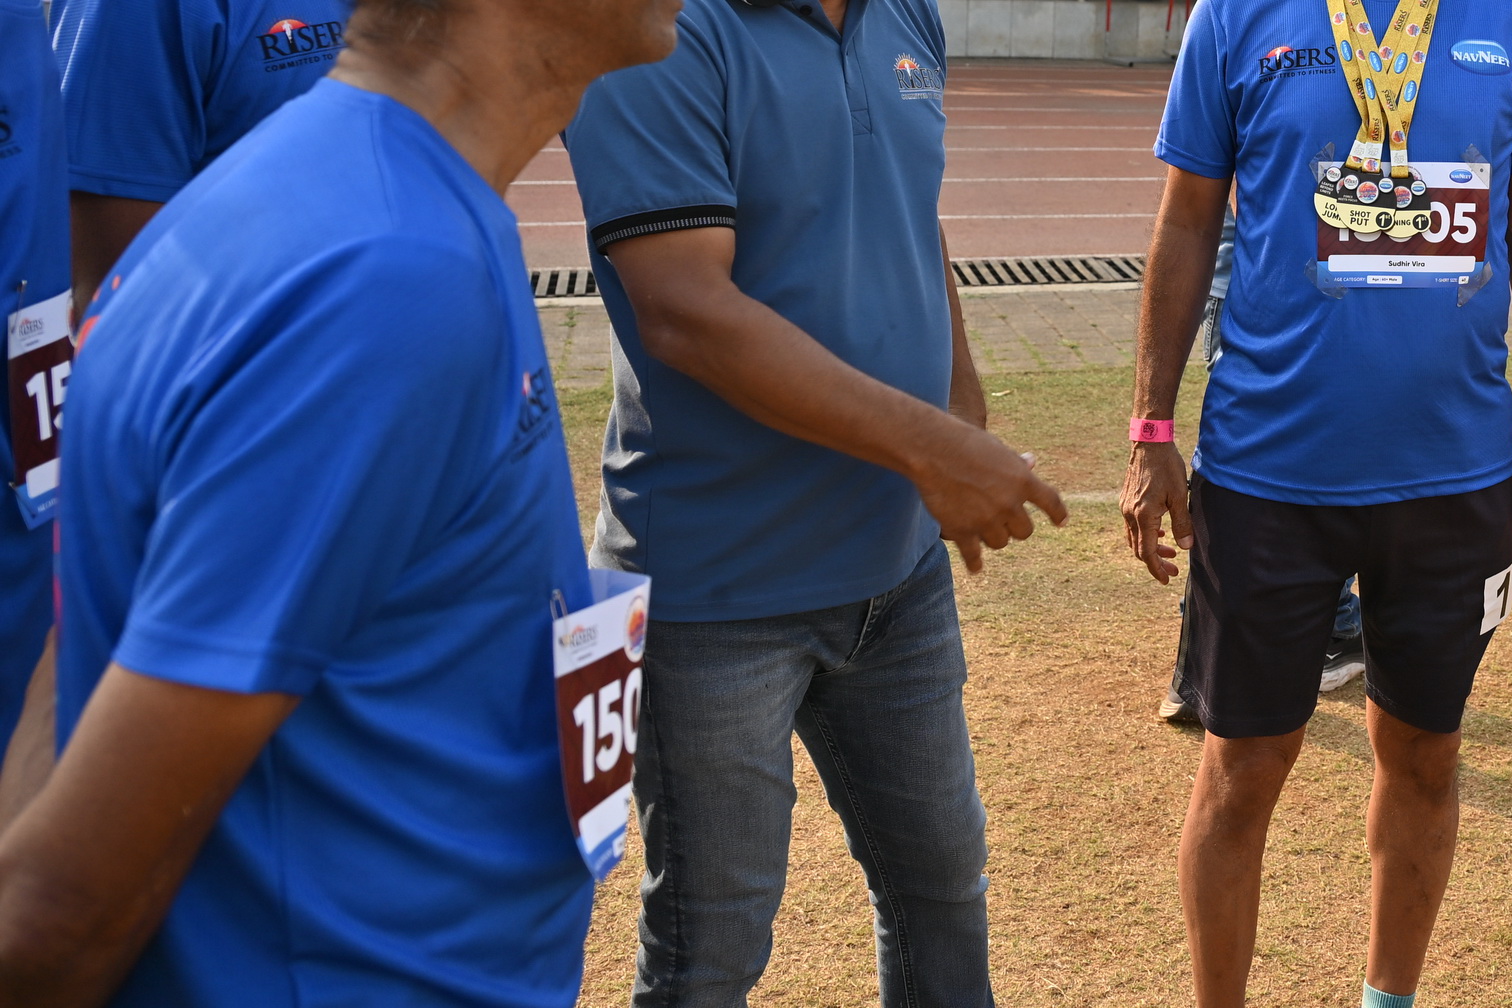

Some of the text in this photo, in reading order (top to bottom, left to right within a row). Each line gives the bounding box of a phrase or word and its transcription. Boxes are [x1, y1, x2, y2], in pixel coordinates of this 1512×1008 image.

[256, 21, 342, 60] RISER
[265, 56, 320, 73] COMMITTED
[1259, 46, 1336, 75] RISERS
[1322, 210, 1341, 221] JUM
[1325, 202, 1337, 212] LO
[1350, 210, 1371, 219] SHOT
[1350, 217, 1369, 226] PUT
[1497, 571, 1511, 620] 1
[573, 668, 642, 784] 150
